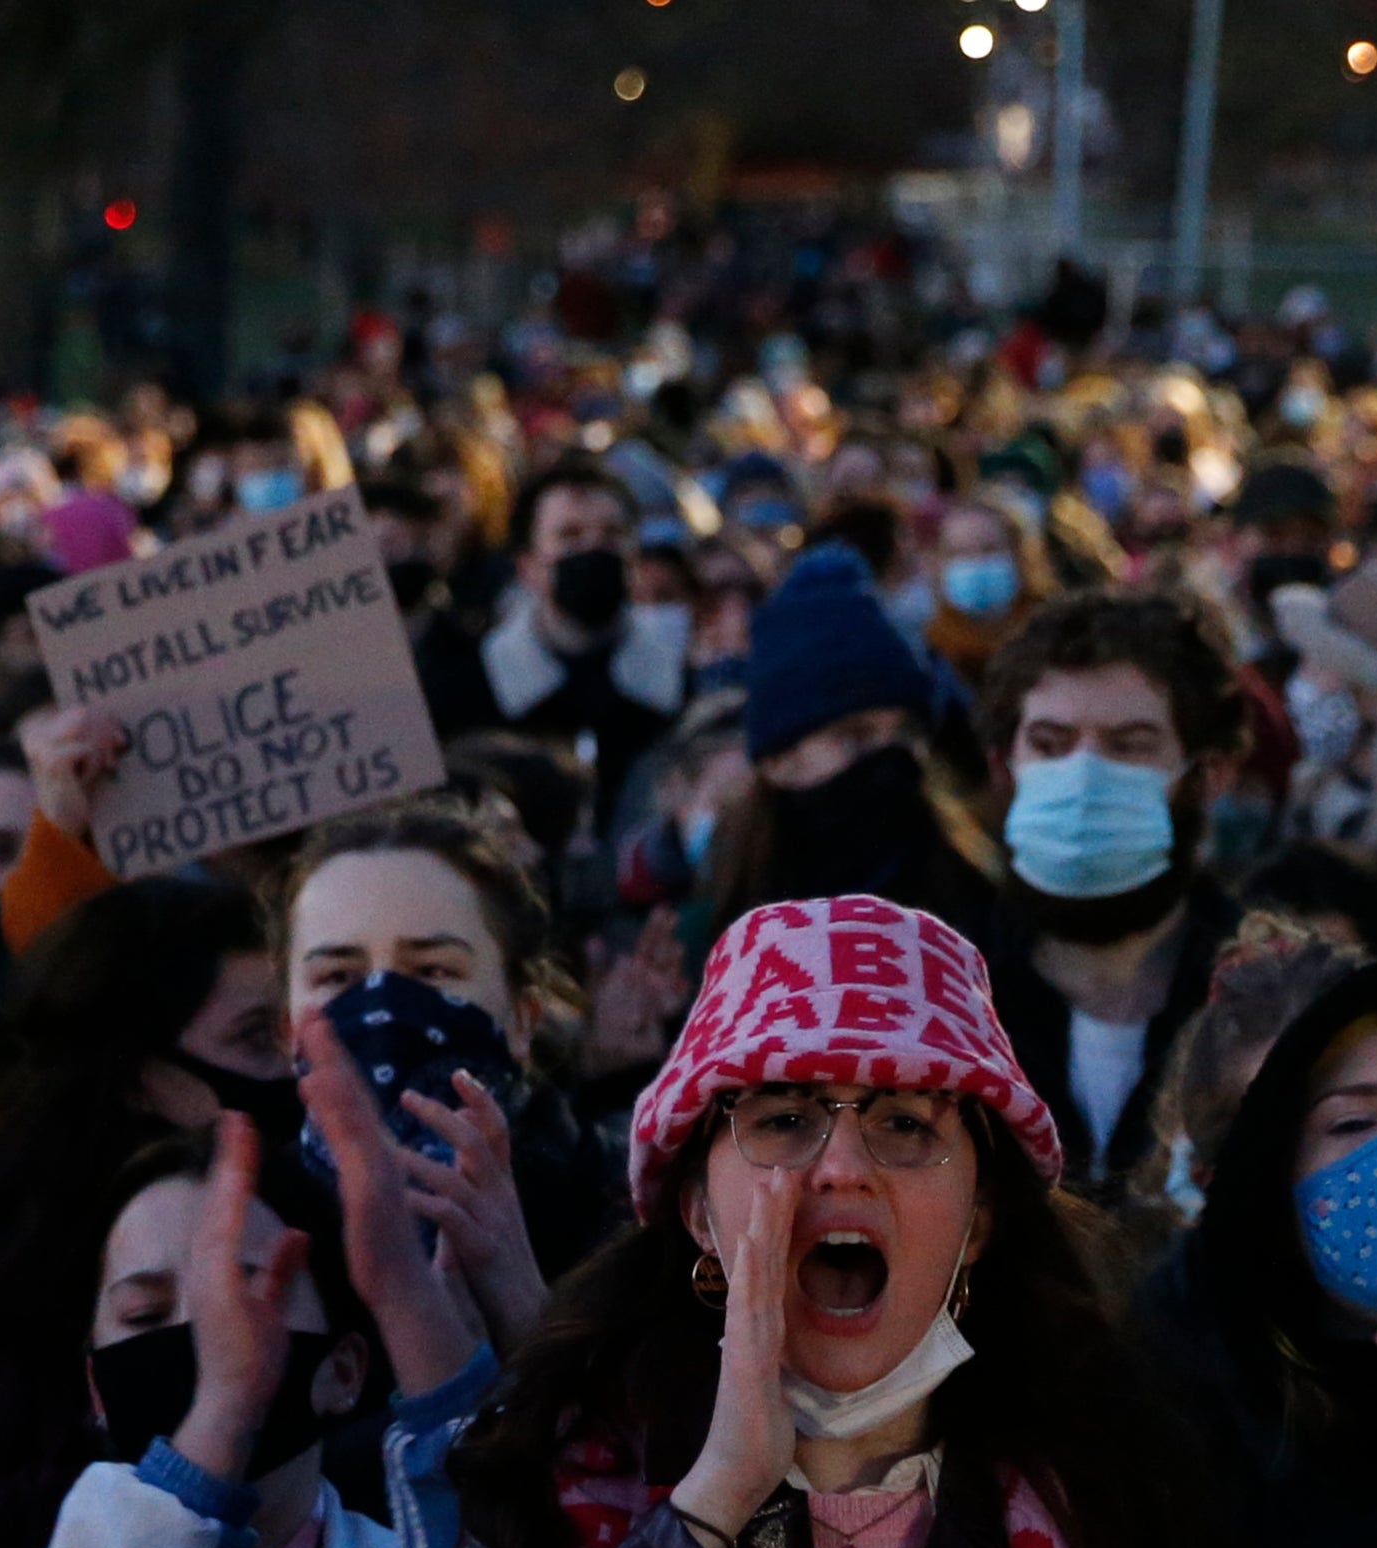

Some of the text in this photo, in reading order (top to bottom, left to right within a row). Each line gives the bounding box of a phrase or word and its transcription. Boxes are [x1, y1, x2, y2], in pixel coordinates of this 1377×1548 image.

[38, 501, 358, 634] WE LIVE IN FEAR
[72, 566, 385, 702] NOT ALL SURVIVE
[109, 746, 402, 876] PROTECT US
[177, 710, 355, 801] DO NOT
